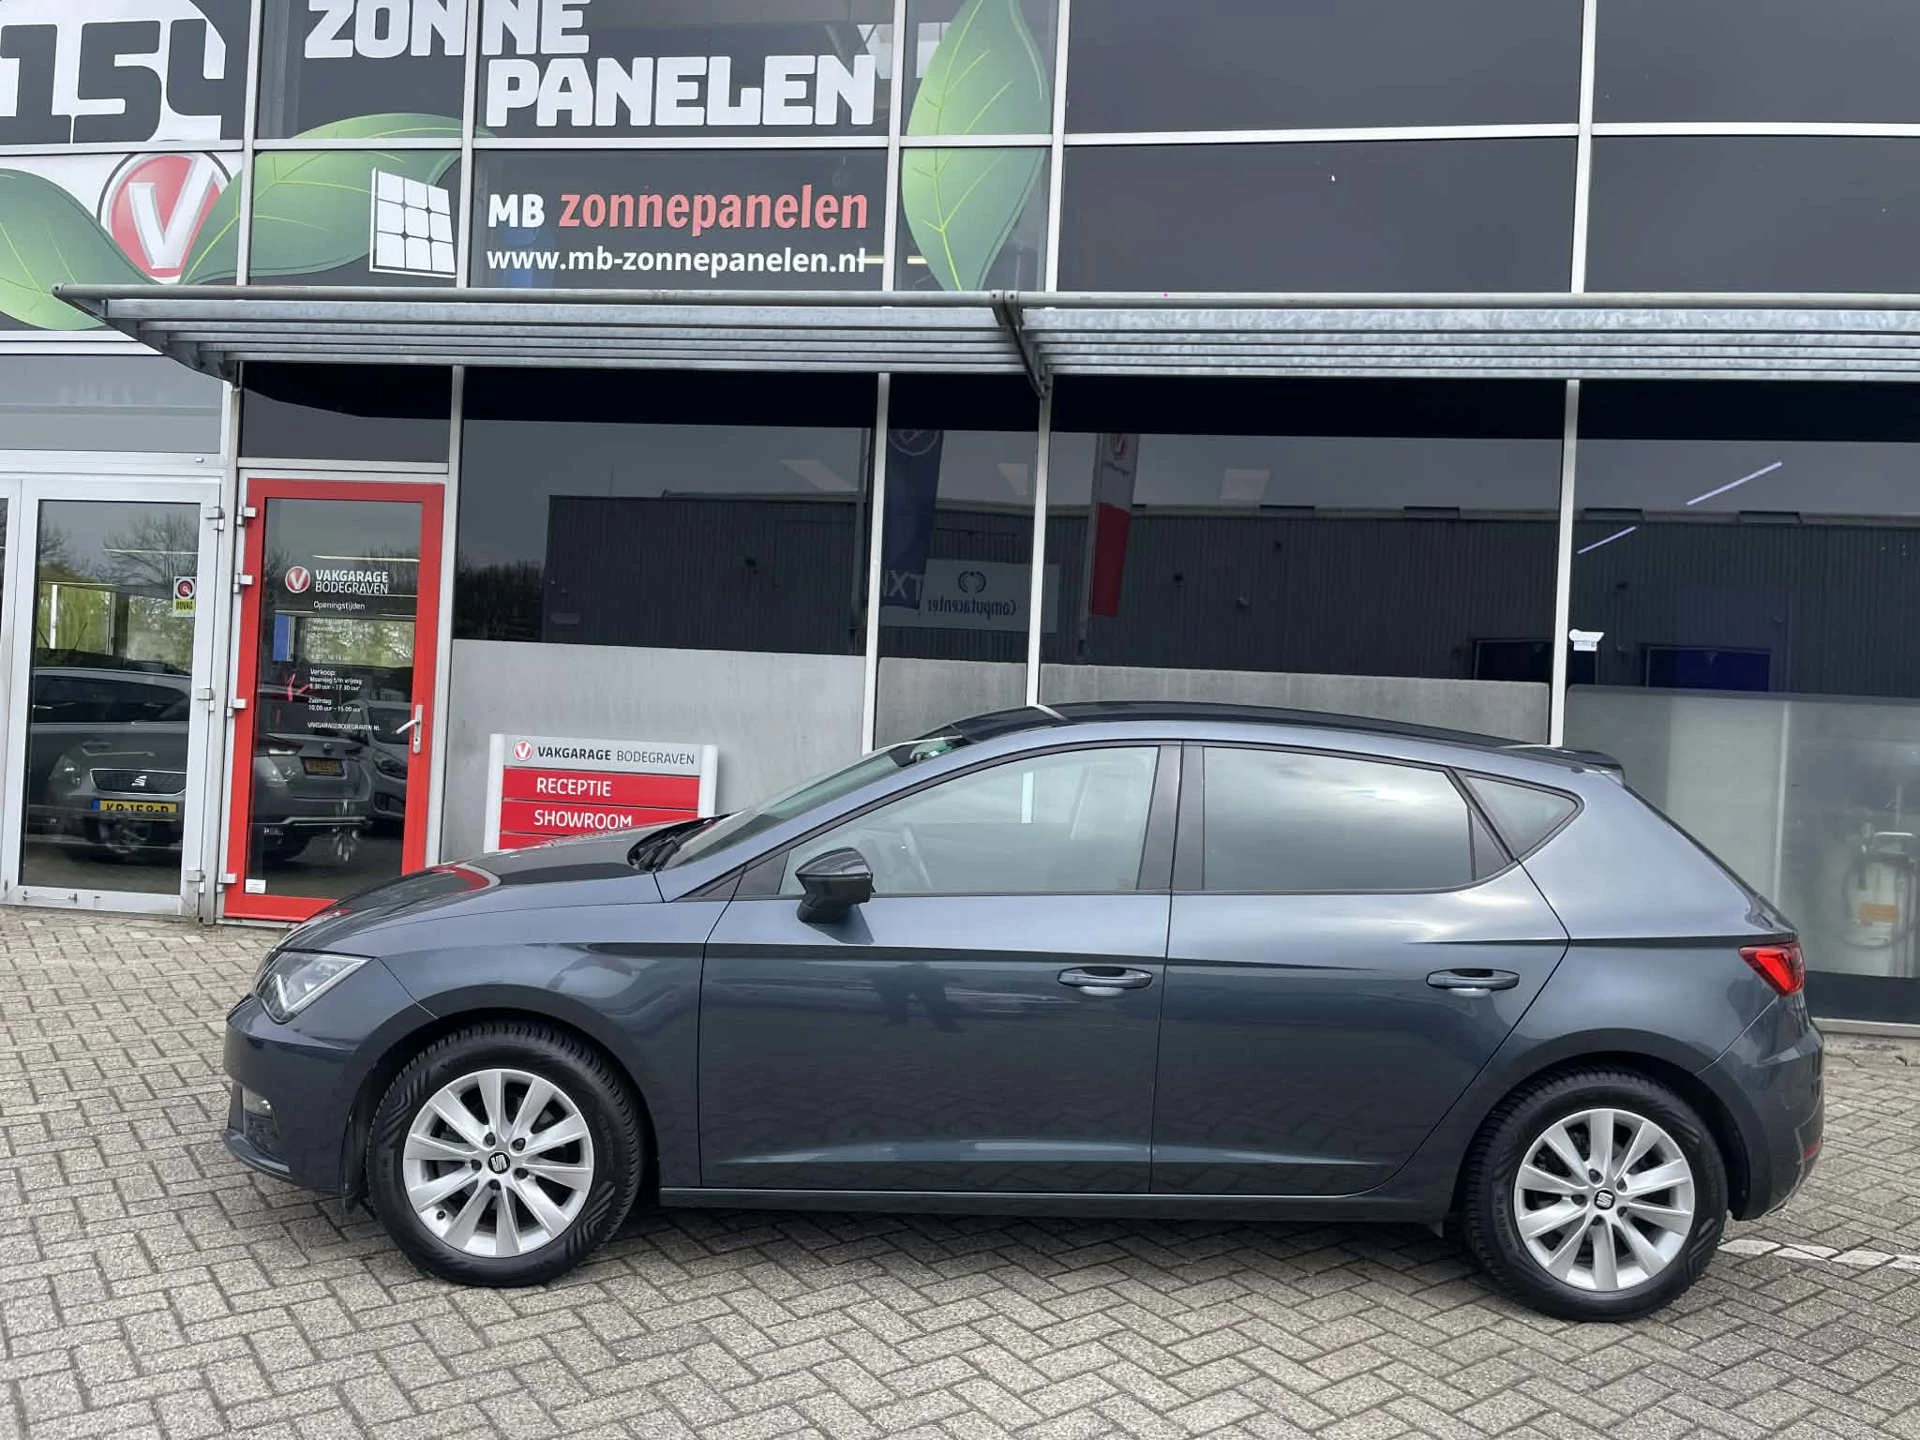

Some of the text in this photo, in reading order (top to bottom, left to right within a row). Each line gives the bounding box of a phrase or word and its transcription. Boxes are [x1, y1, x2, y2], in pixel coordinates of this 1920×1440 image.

[487, 55, 875, 127] PANELEN
[487, 185, 868, 236] MB zonnepanelen
[487, 246, 866, 277] www.mb-zonnepanelen.nl
[315, 569, 389, 583] VAKGARAGE
[315, 581, 389, 594] BODEGRAVEN
[313, 600, 366, 611] Openingstijden
[538, 746, 611, 761] VAKGARAGE
[617, 751, 695, 765] BODEGRAVEN
[536, 777, 612, 797] RECEPTIE
[533, 809, 632, 829] SHOWROOM
